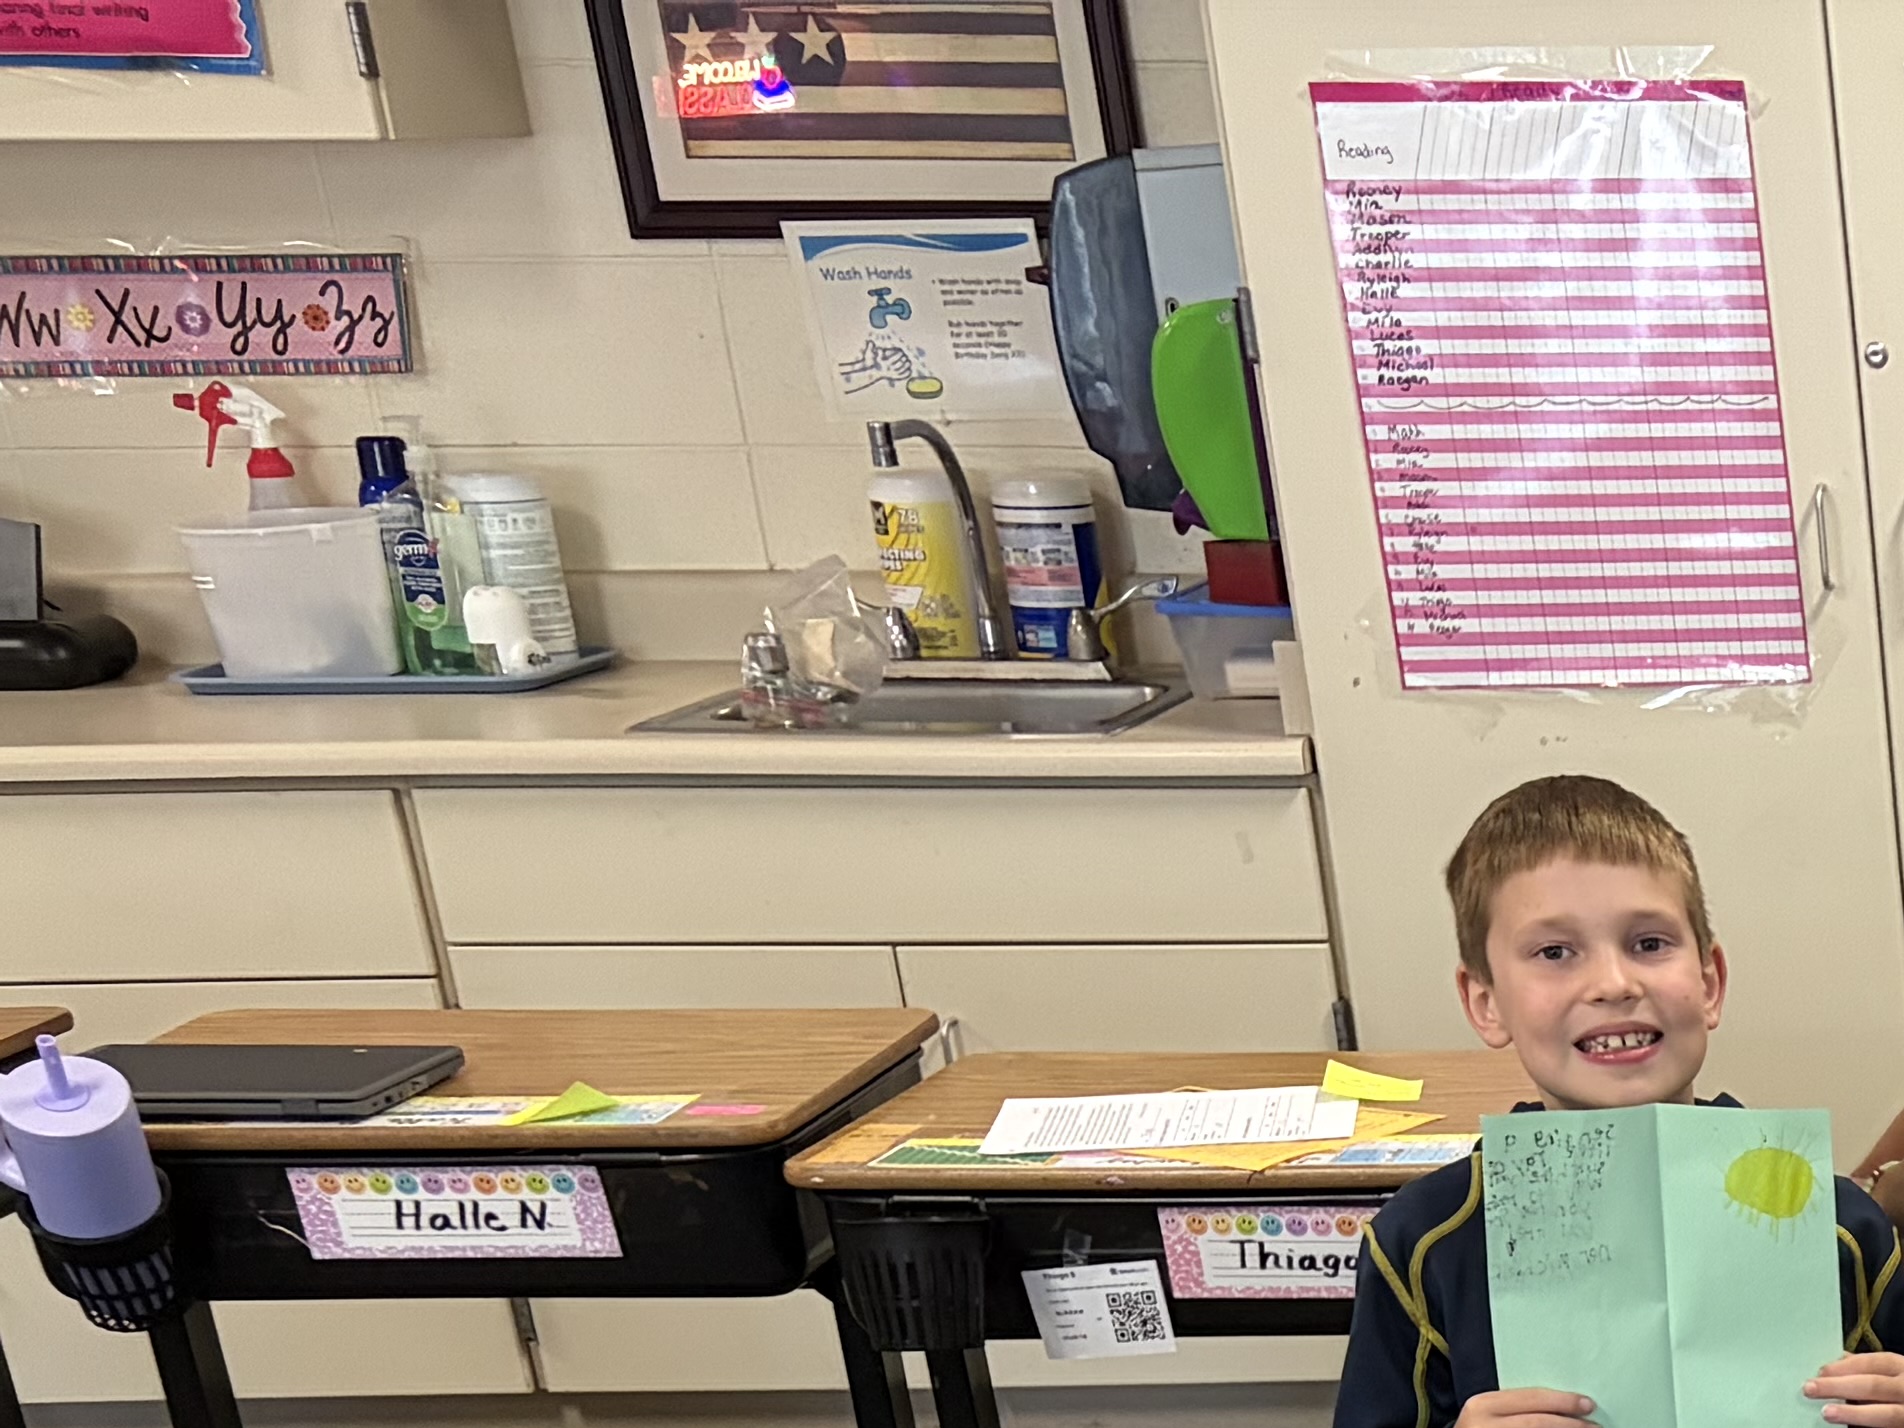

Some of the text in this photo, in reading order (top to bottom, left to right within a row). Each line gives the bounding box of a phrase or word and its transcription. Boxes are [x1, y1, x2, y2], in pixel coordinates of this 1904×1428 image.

[1337, 140, 1393, 164] Reading
[819, 266, 912, 281] Wash Hands
[95, 287, 172, 348] Xx
[215, 280, 296, 356] Yy
[395, 1200, 509, 1231] Halle
